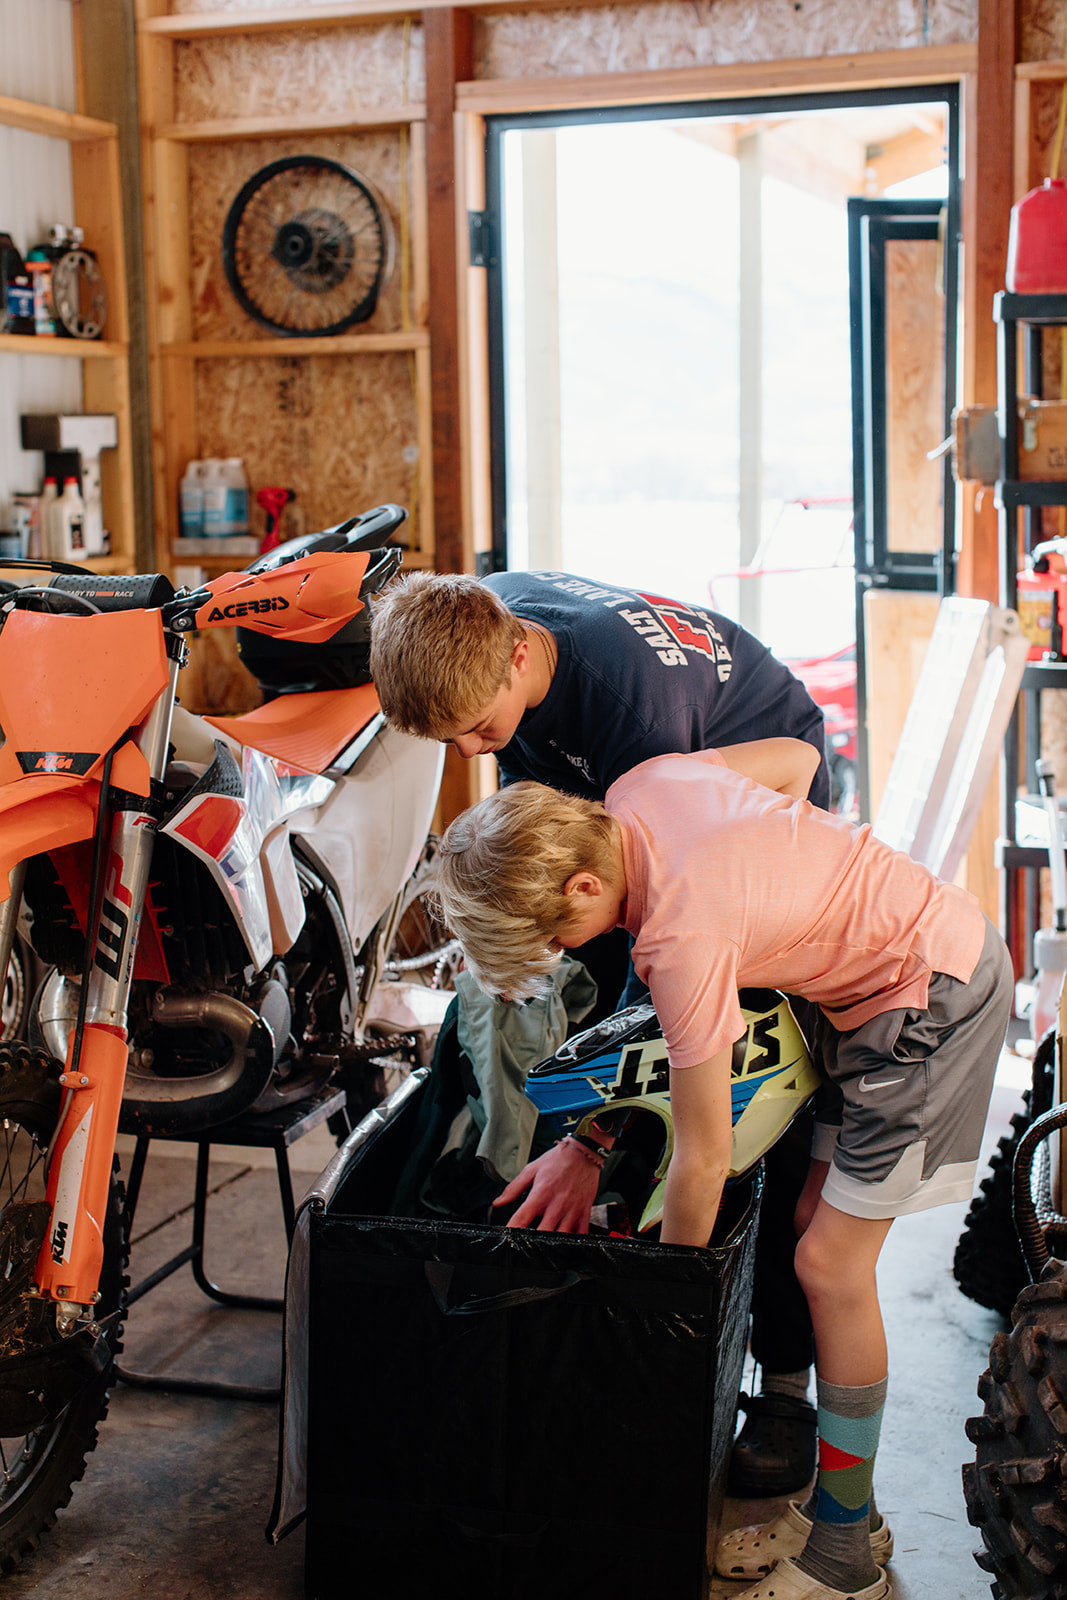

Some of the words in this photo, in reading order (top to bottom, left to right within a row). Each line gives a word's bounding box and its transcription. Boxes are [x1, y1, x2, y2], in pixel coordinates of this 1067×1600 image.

[114, 590, 134, 598] RACE
[553, 579, 636, 608] LAKE
[207, 595, 290, 622] ACERBIS
[617, 608, 689, 667] SALT
[34, 755, 74, 770] KTM
[50, 1220, 69, 1266] KTM
